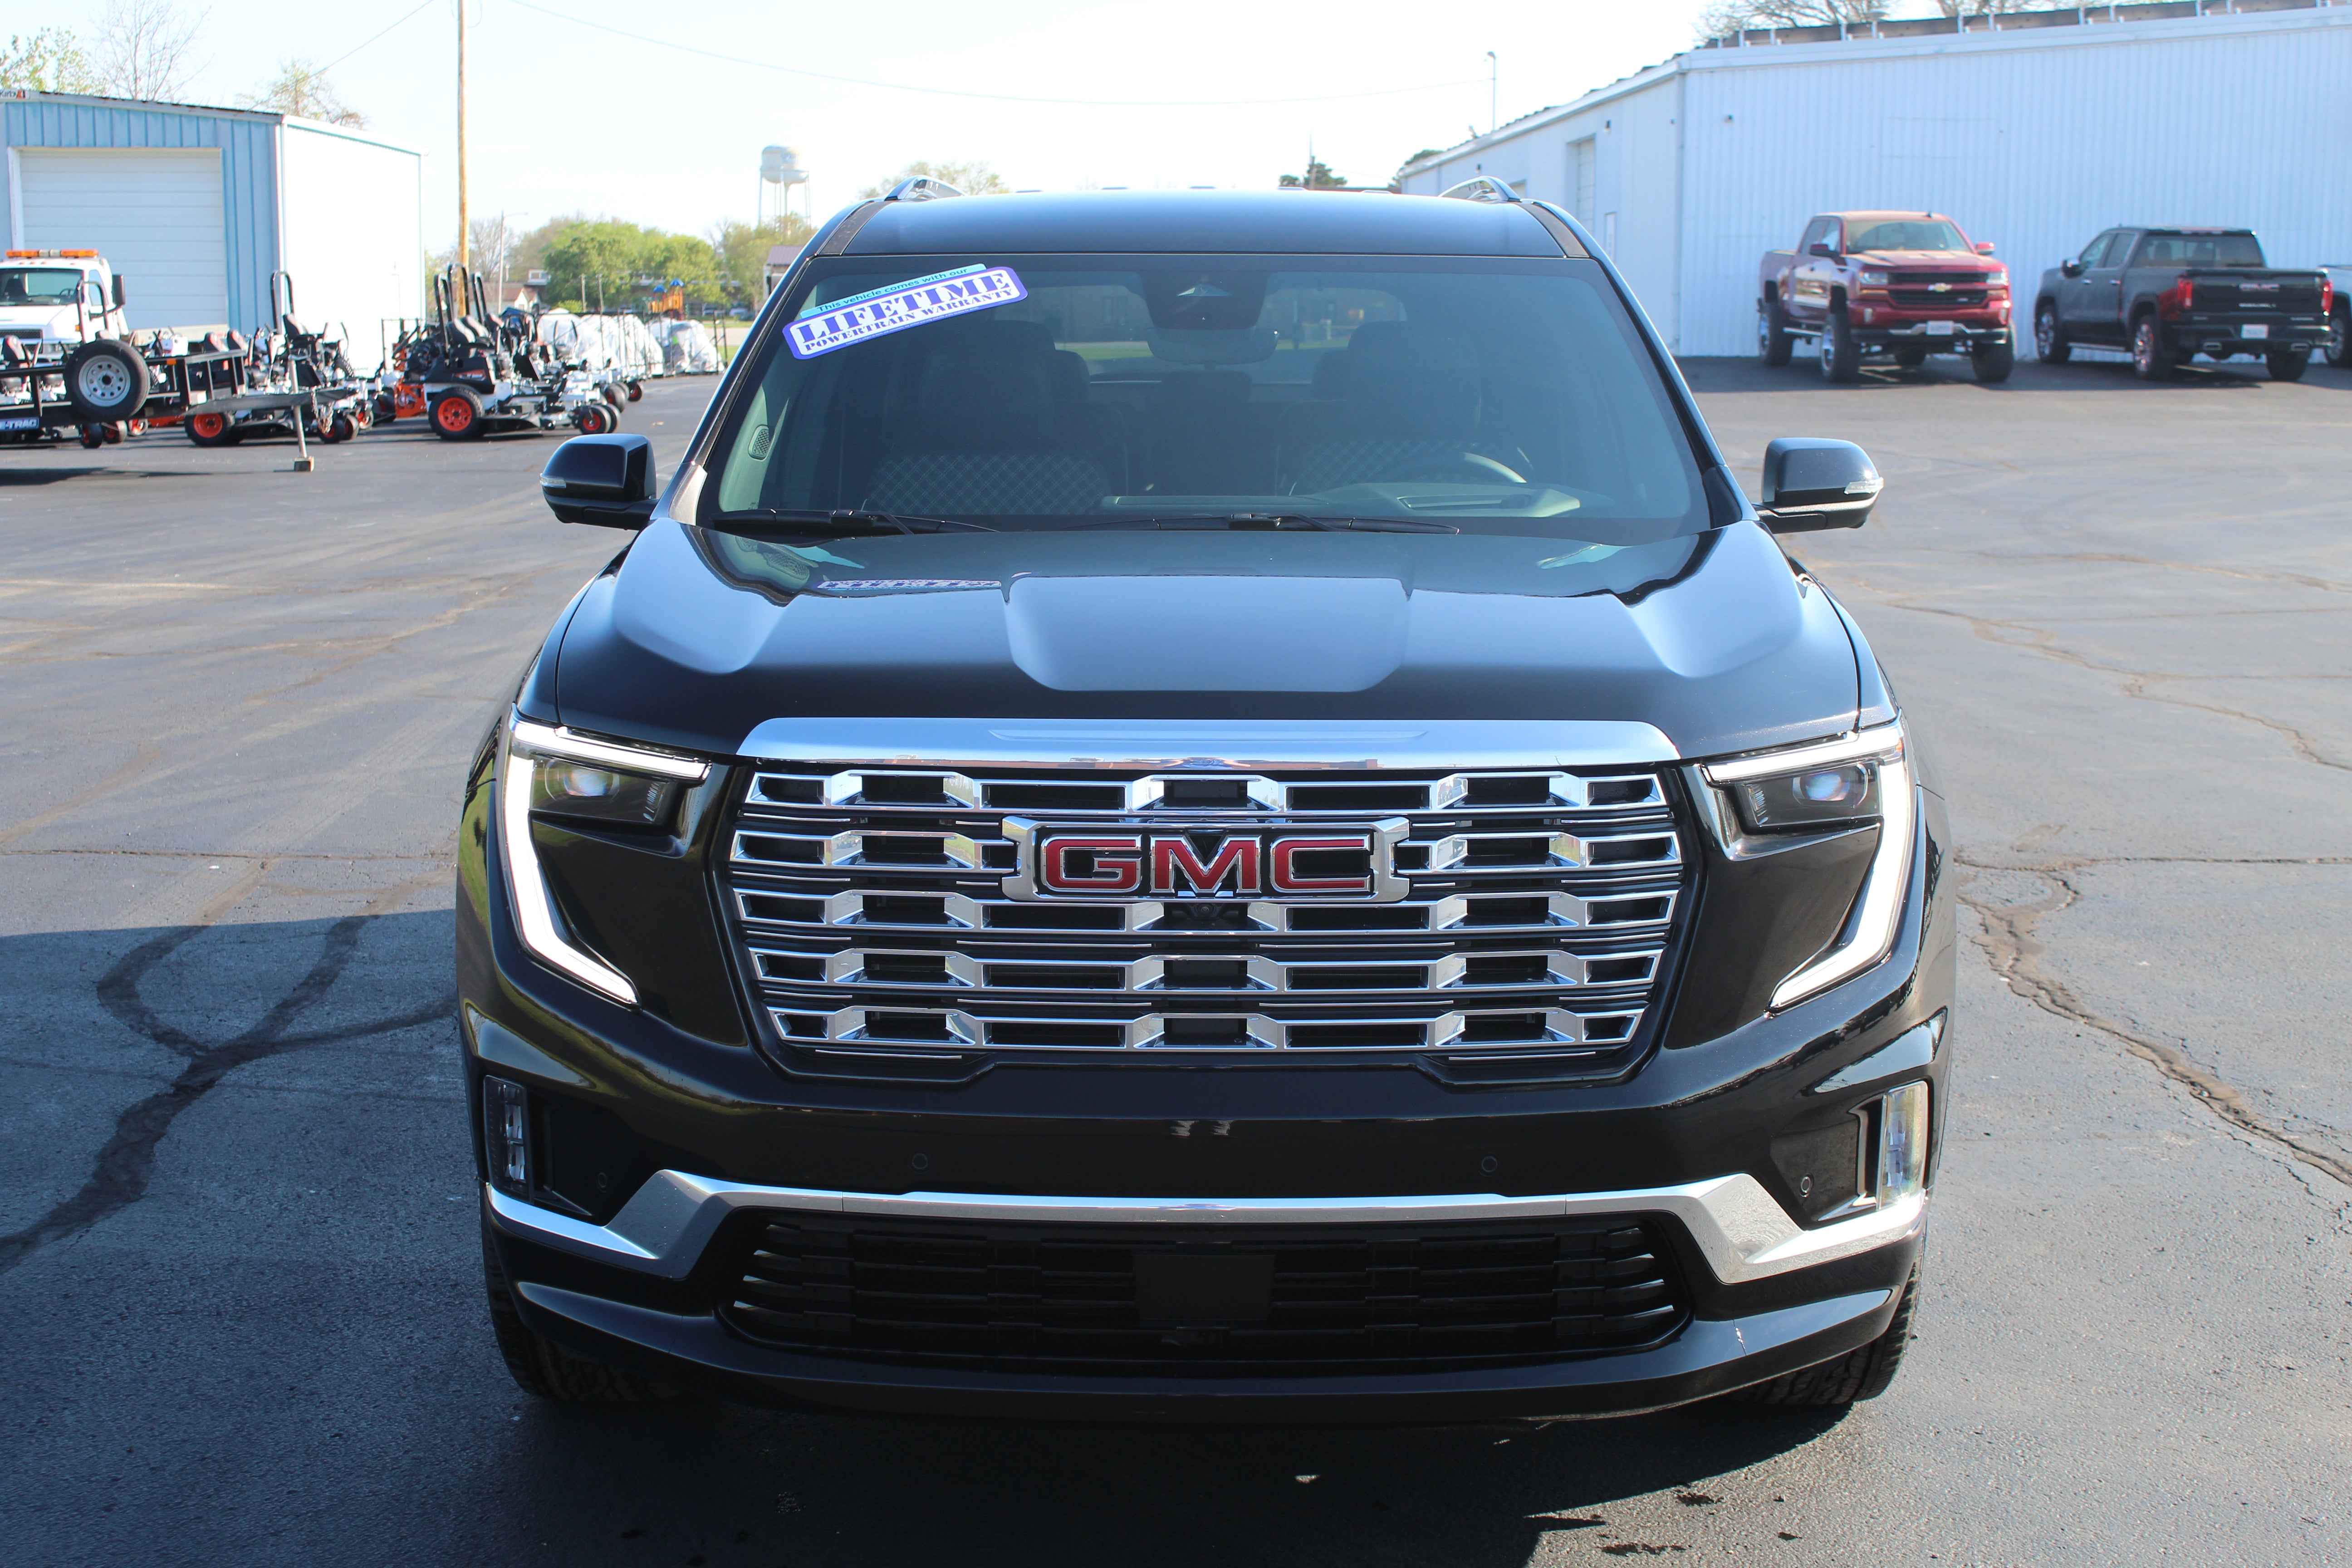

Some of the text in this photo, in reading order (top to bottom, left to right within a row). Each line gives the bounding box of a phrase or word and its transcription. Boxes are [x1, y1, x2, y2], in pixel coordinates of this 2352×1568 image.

[797, 273, 1010, 343] LIFETIME
[804, 289, 1012, 351] POWERTRAIN WARRANTY
[817, 302, 841, 312] This
[843, 290, 882, 304] vehicle
[884, 280, 920, 292] comes
[921, 273, 947, 283] with
[1041, 834, 1371, 894] GMC
